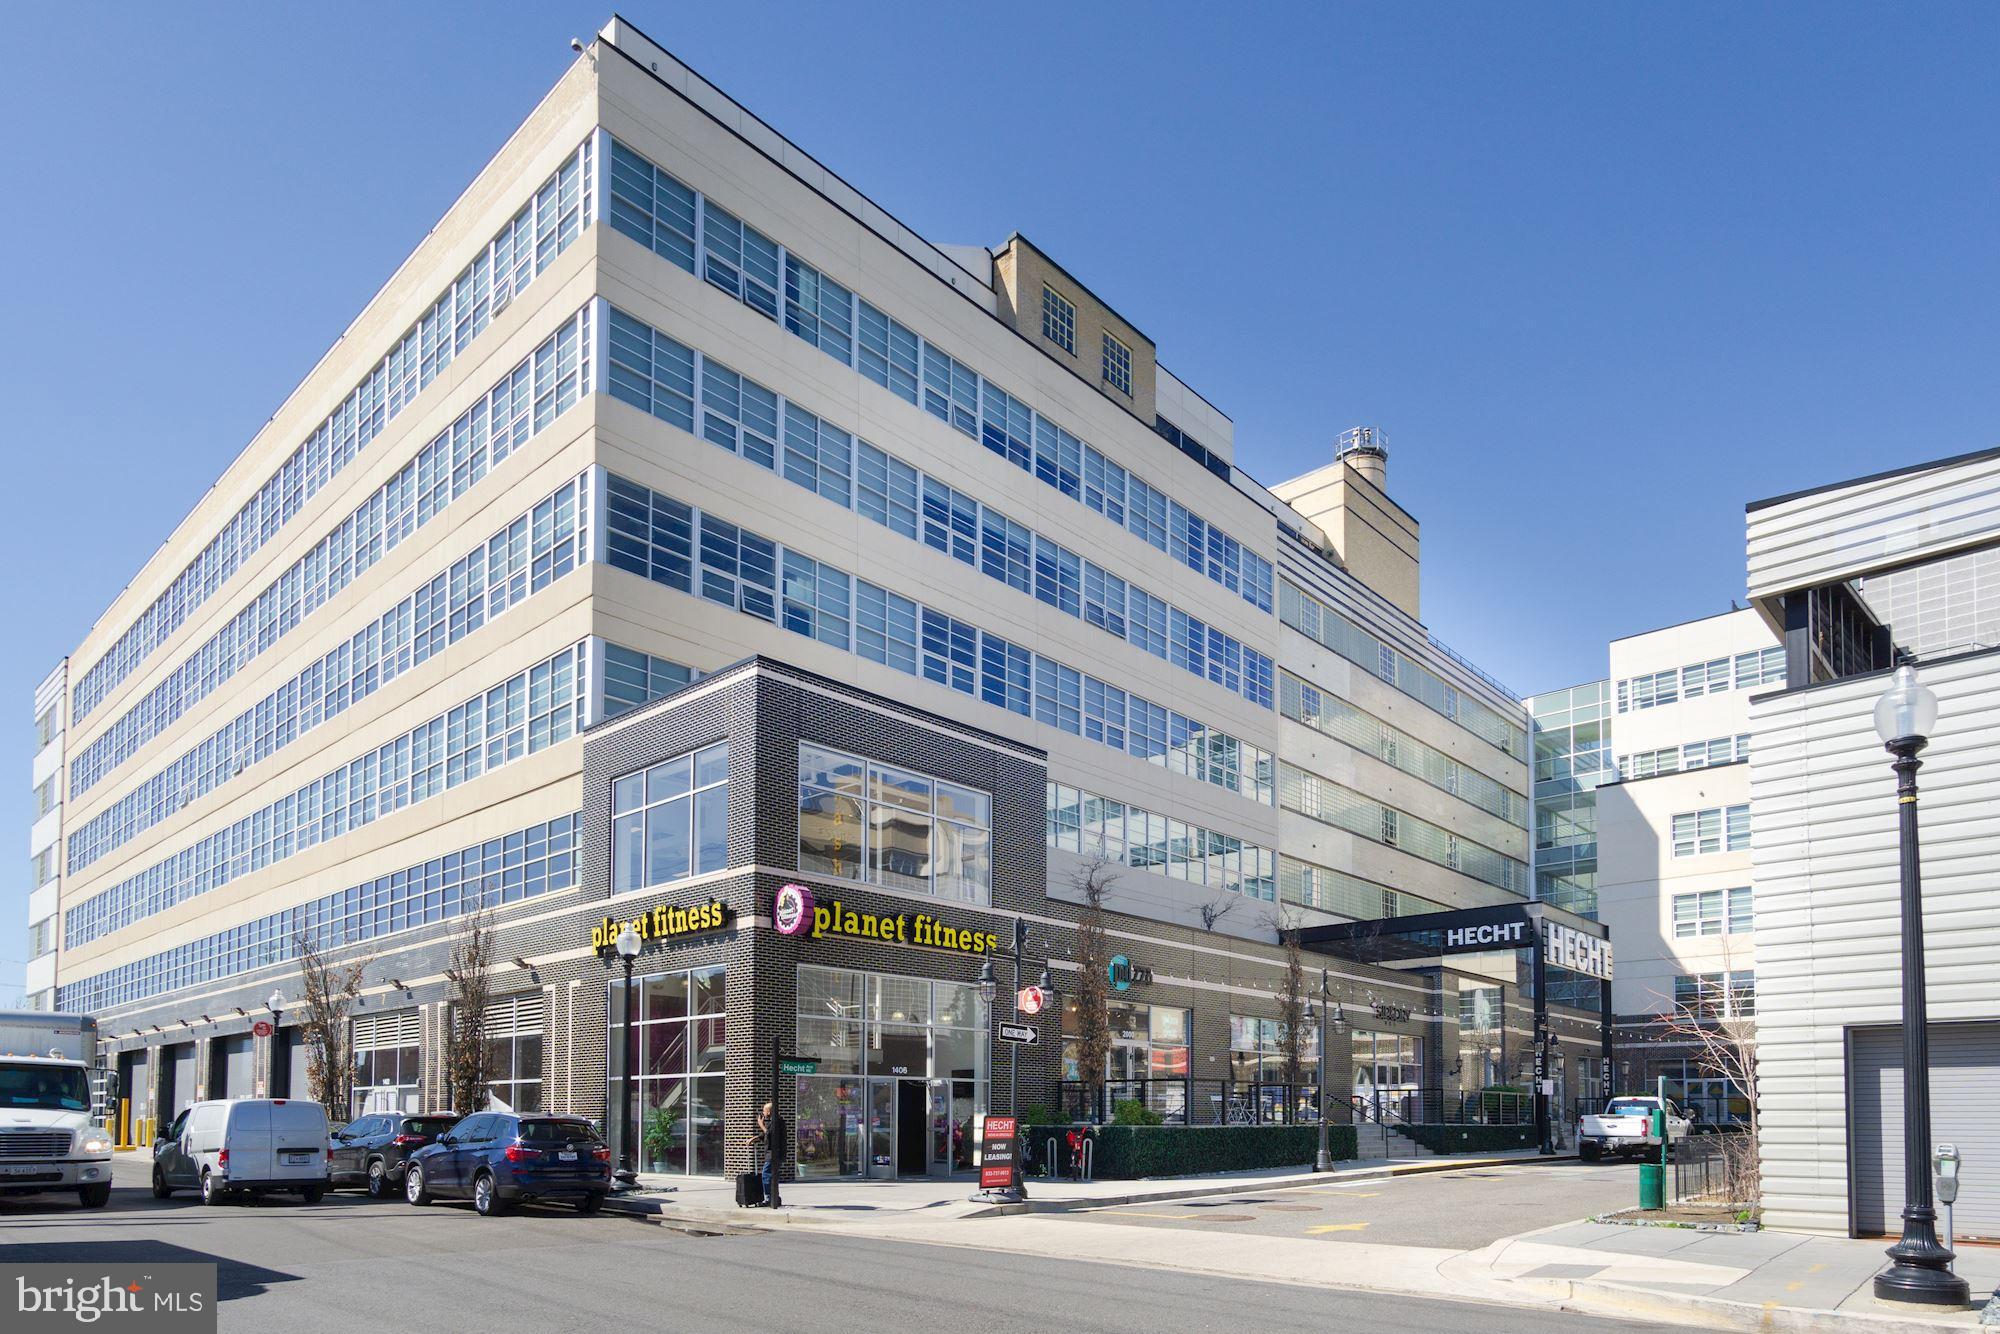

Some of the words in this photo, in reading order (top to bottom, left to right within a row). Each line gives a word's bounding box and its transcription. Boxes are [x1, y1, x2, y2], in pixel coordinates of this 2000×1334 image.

[591, 911, 649, 956] plaet
[653, 901, 723, 938] fitness
[811, 901, 906, 939] planet
[913, 914, 998, 952] fitness
[1447, 921, 1525, 947] HECHT
[1548, 922, 1612, 977] HECHT
[1004, 1028, 1016, 1037] ONE
[1016, 1030, 1028, 1038] WAY
[783, 1063, 805, 1073] Hecht
[986, 1120, 1014, 1130] HECHT
[984, 1153, 1012, 1161] LEASING!
